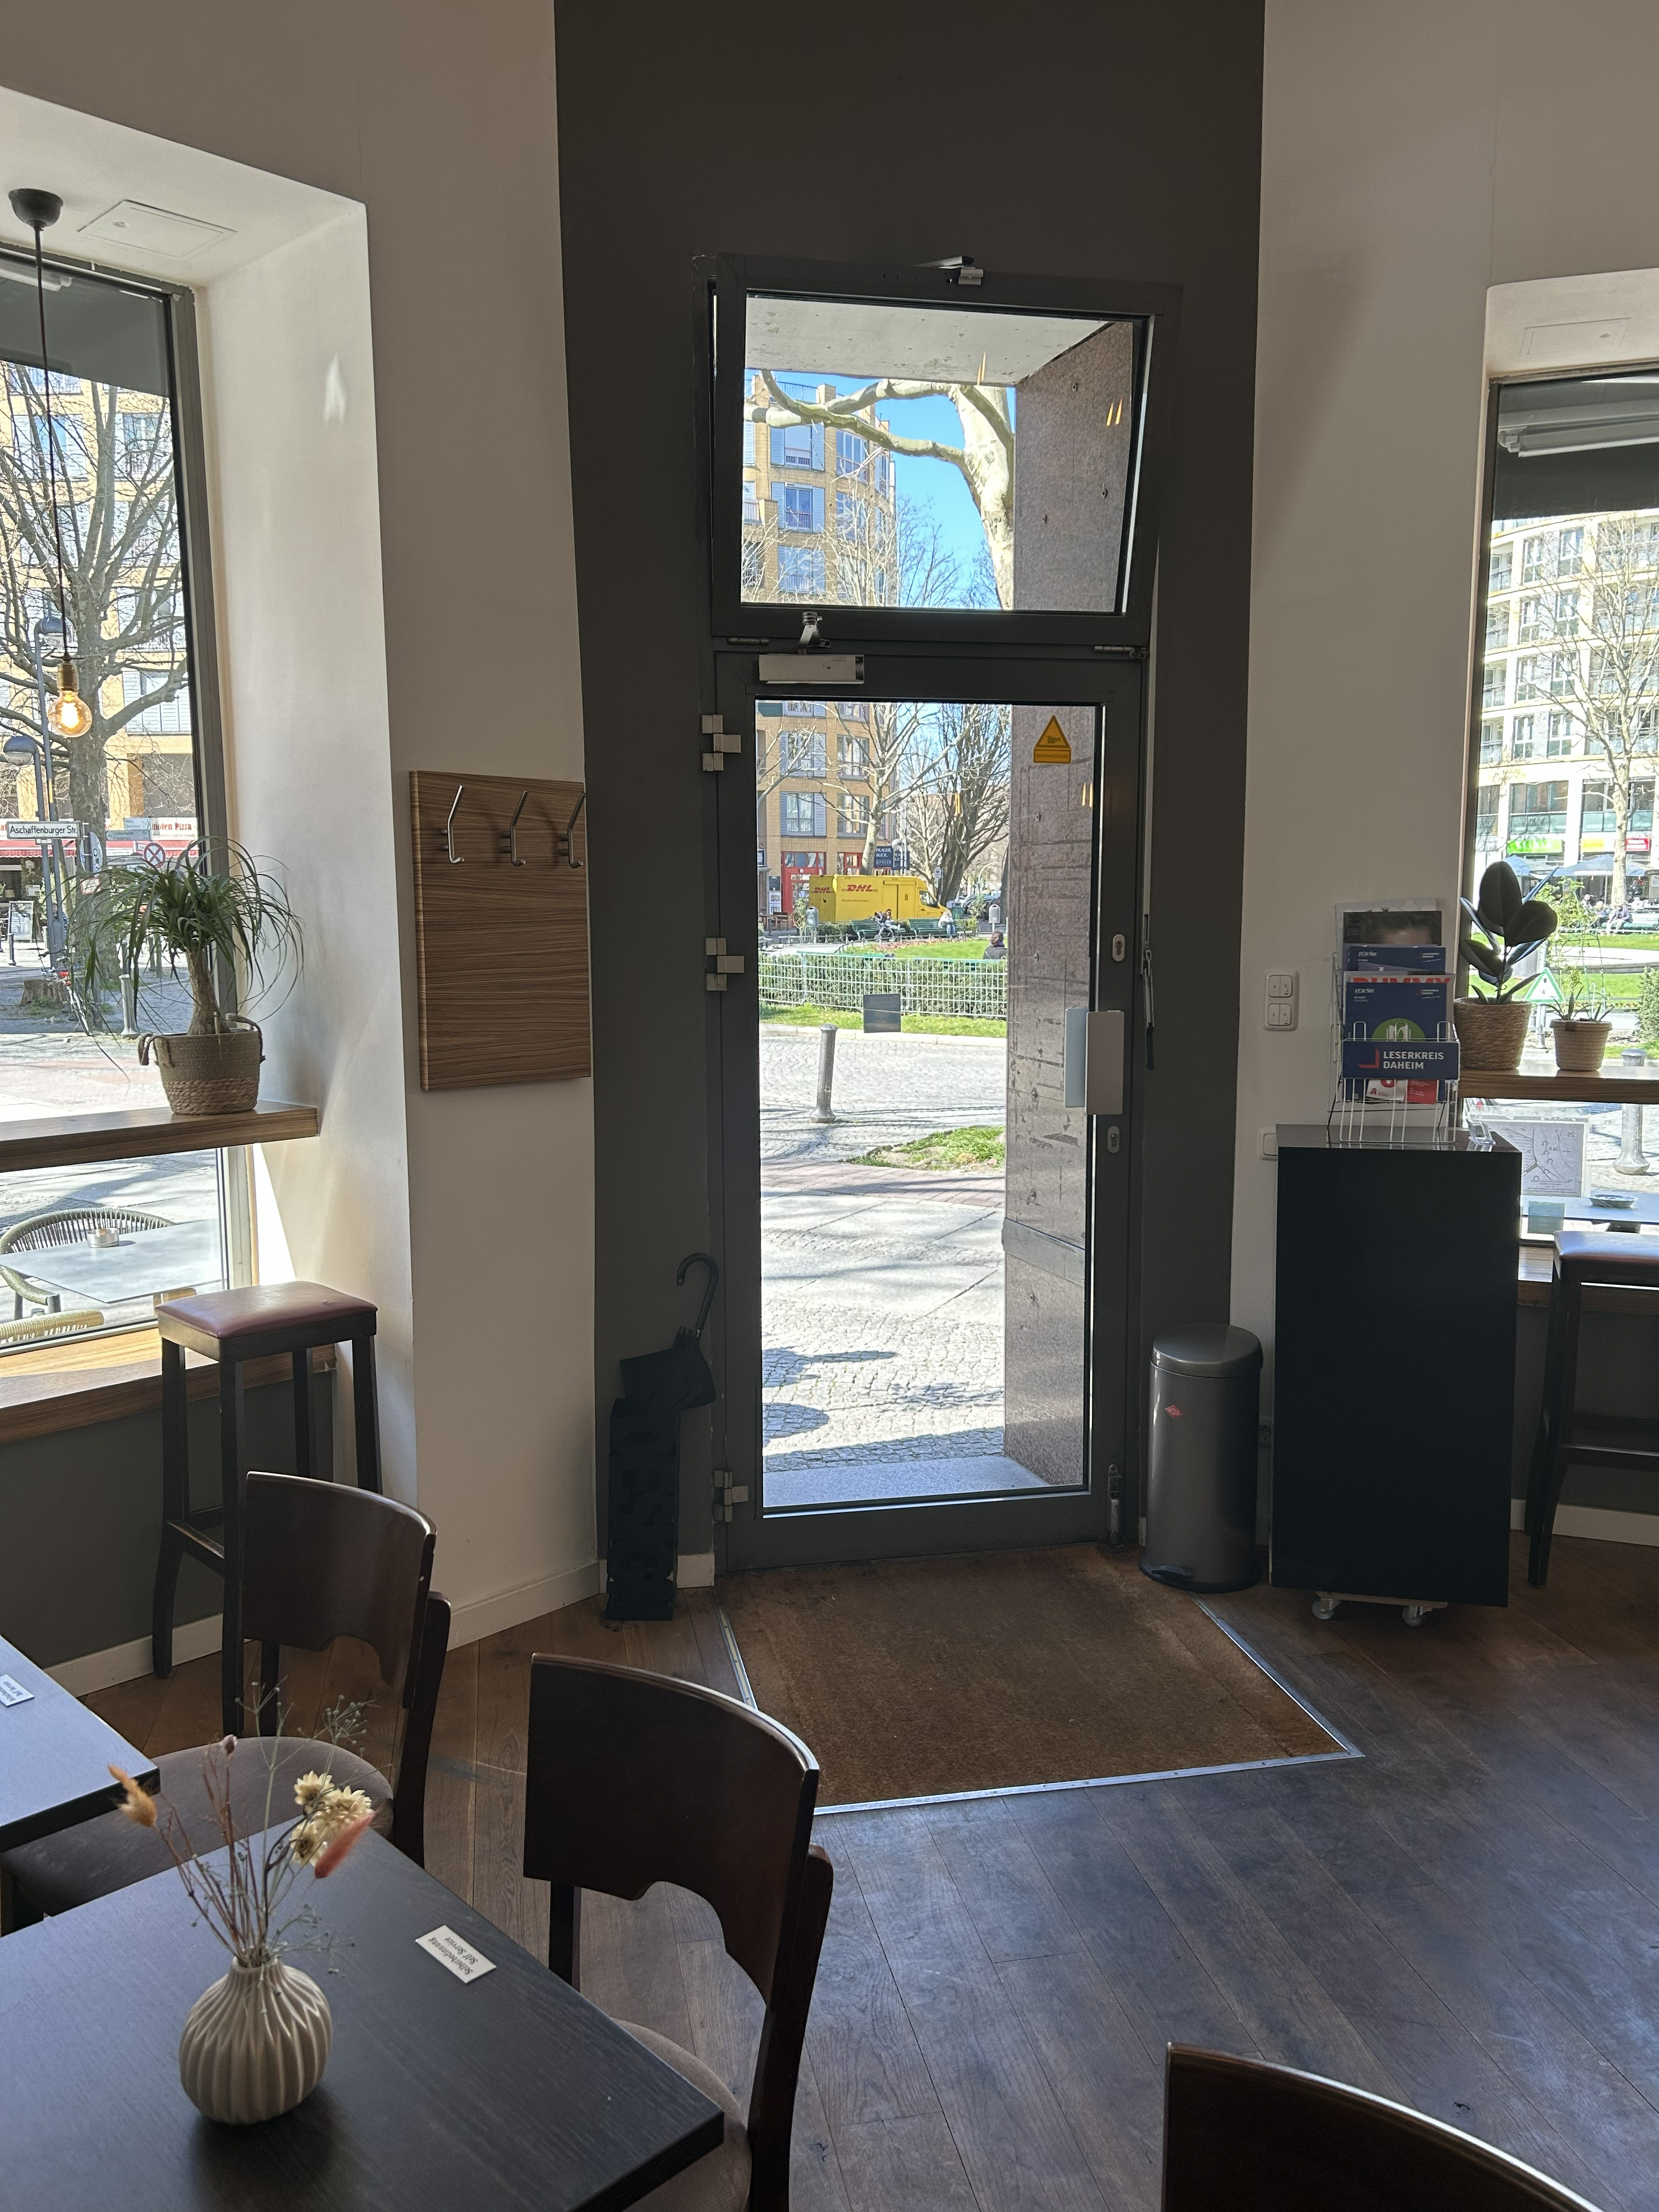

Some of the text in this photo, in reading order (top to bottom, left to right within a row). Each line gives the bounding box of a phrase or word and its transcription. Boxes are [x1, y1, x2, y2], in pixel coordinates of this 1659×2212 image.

[10, 825, 65, 835] Aschaffenburger
[1383, 1051, 1444, 1060] LESERKREIS
[1383, 1061, 1425, 1070] DAHEIM
[444, 1937, 478, 1964] Self Service
[429, 1937, 473, 1975] Selbstbedienung
